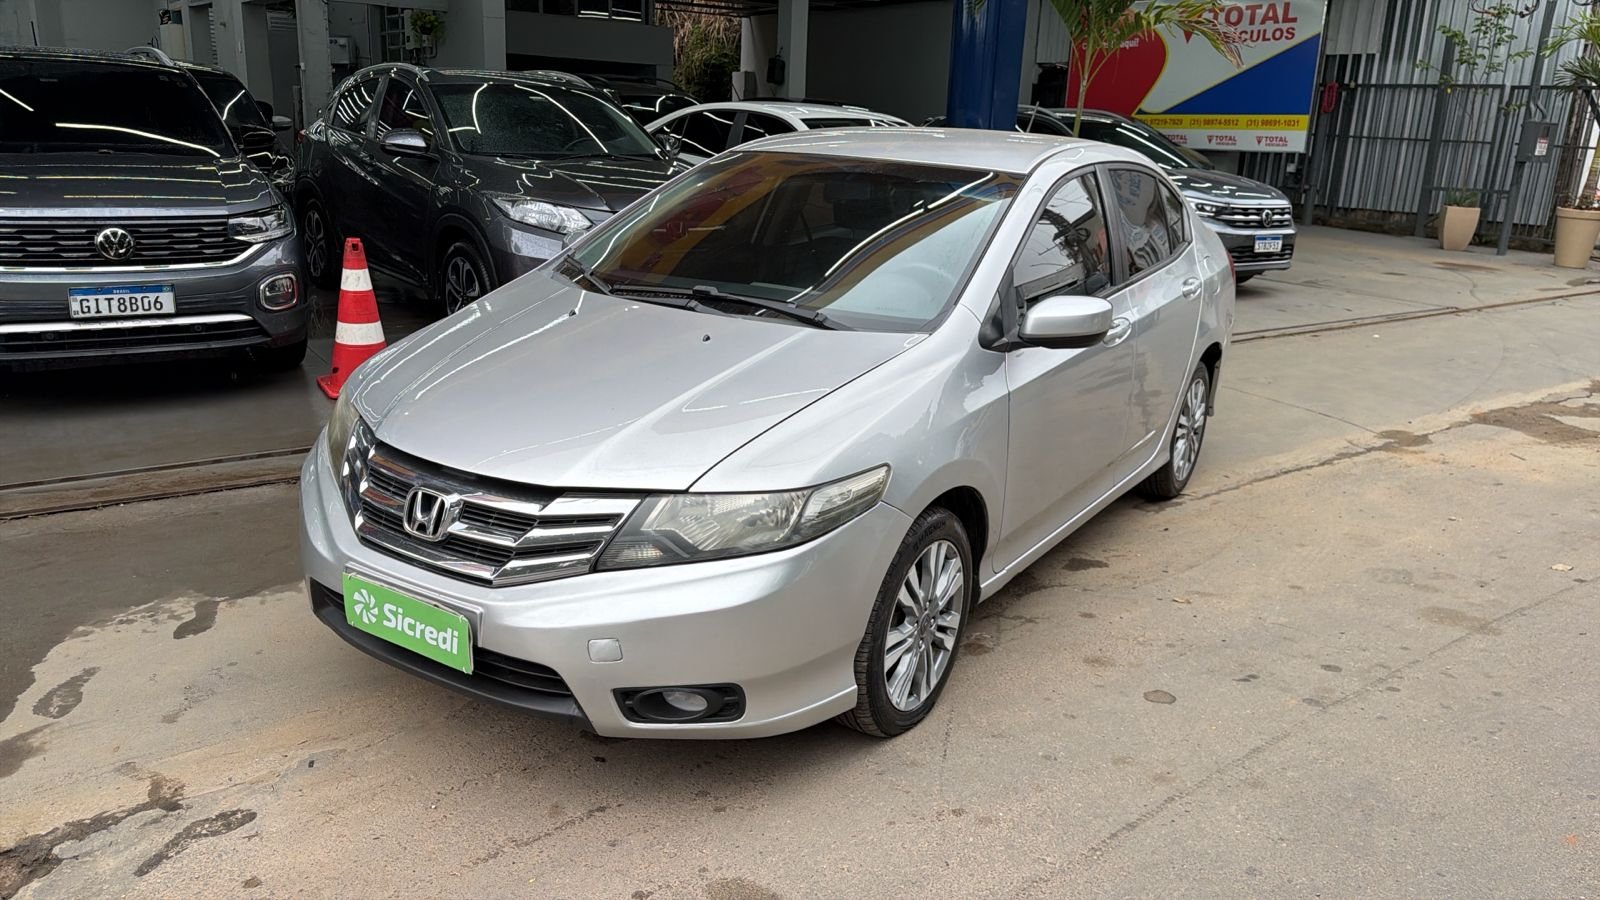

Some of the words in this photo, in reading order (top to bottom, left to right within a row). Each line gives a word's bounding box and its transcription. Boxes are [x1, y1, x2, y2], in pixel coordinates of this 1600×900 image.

[1208, 2, 1298, 27] TOTAL
[79, 295, 164, 315] GIT8B06
[383, 603, 459, 655] Sicredi
